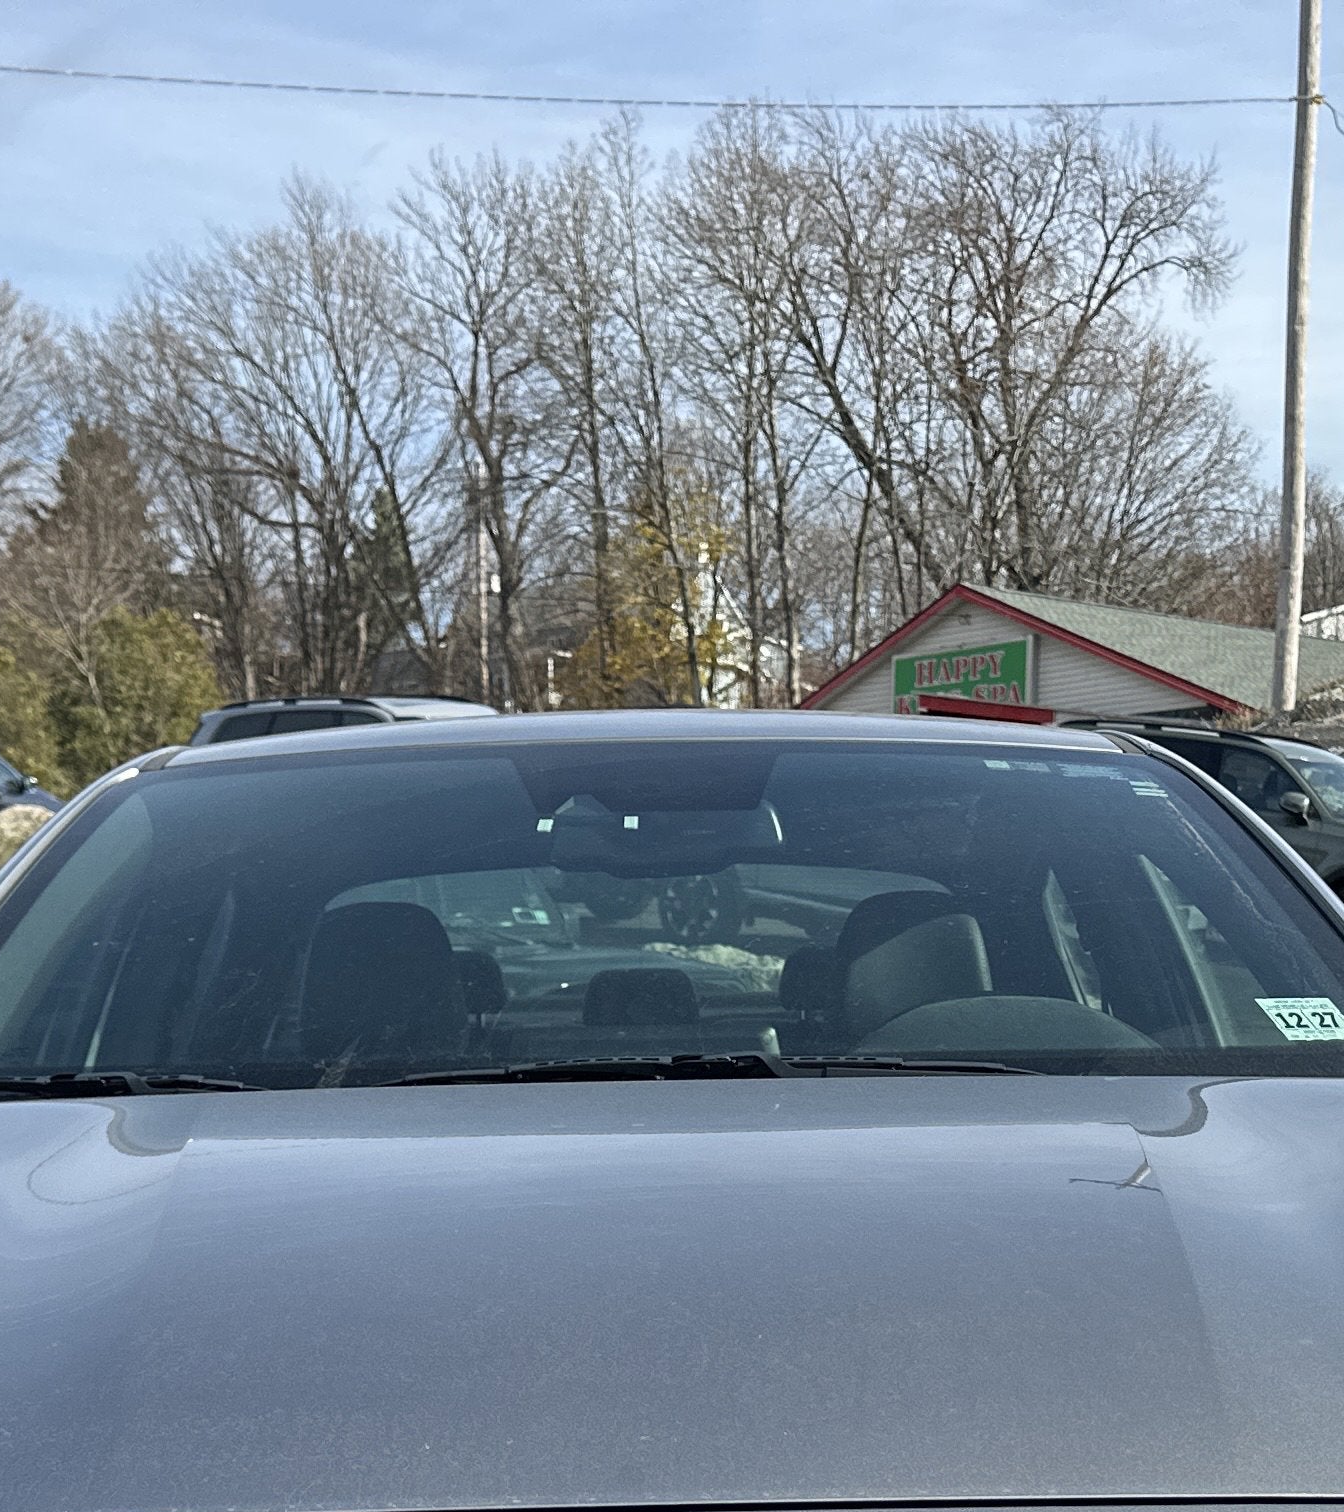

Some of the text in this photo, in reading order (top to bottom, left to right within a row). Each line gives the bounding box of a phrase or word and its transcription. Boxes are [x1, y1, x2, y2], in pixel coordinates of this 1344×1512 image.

[914, 651, 1005, 688] HAPPY
[972, 681, 1022, 705] SPA
[1275, 1012, 1340, 1029] 12 27
